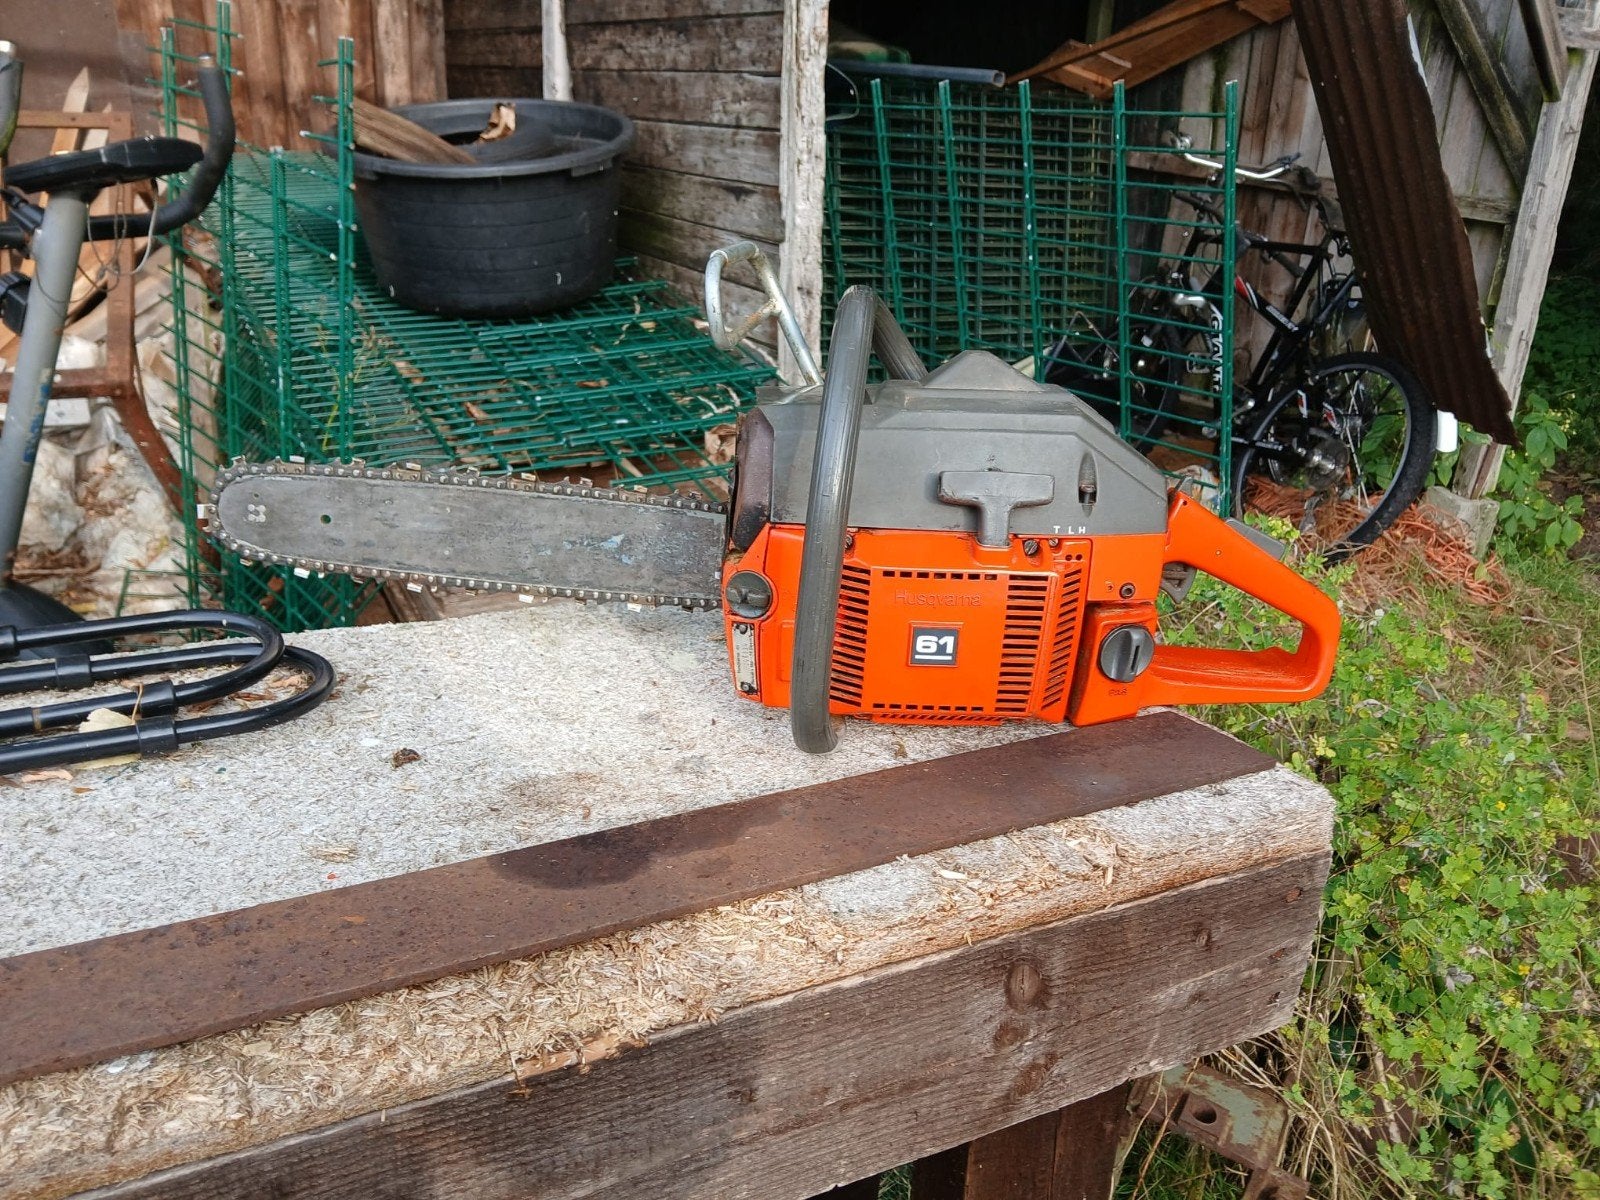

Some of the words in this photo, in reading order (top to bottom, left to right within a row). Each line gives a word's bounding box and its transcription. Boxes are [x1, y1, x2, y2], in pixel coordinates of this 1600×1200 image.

[1053, 525, 1061, 534] T
[1068, 525, 1075, 535] L
[1078, 525, 1086, 534] H
[894, 589, 982, 609] Husqvarna
[915, 635, 955, 654] 61
